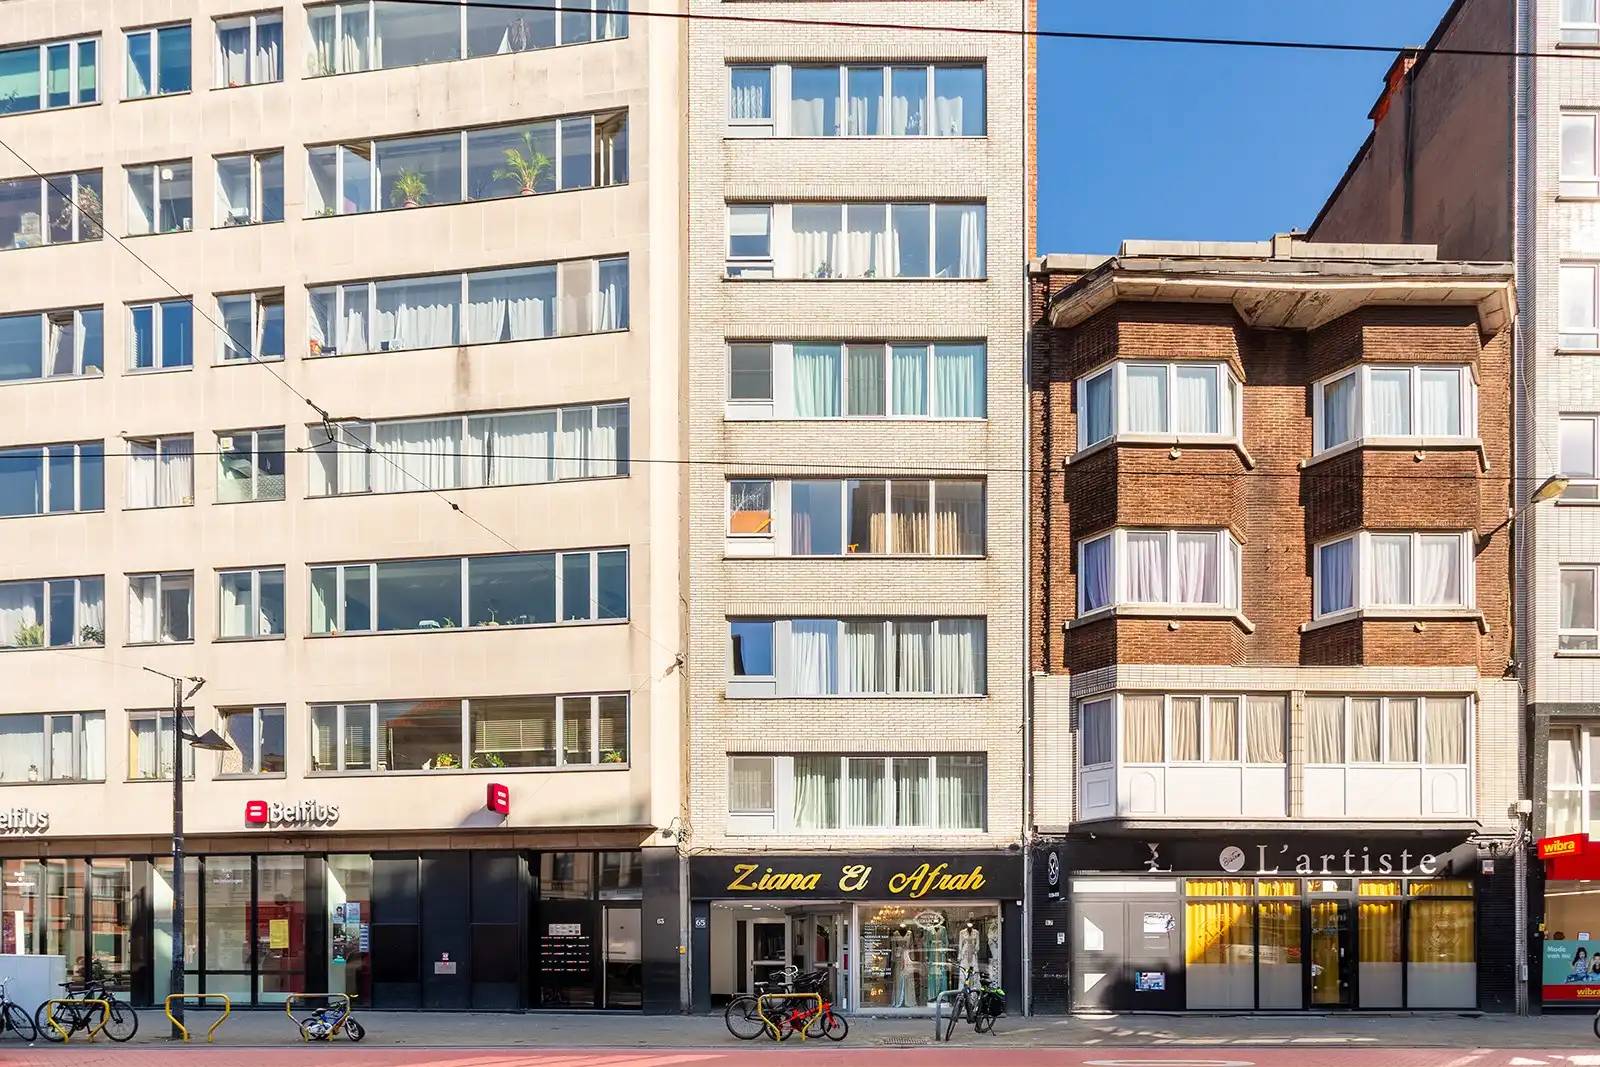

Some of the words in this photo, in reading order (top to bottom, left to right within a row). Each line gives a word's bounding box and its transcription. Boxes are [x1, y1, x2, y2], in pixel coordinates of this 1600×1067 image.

[270, 800, 340, 823] Belfius
[1544, 839, 1575, 853] wibra
[727, 863, 822, 891] Ziana
[838, 864, 872, 892] El
[888, 862, 986, 898] Afrah
